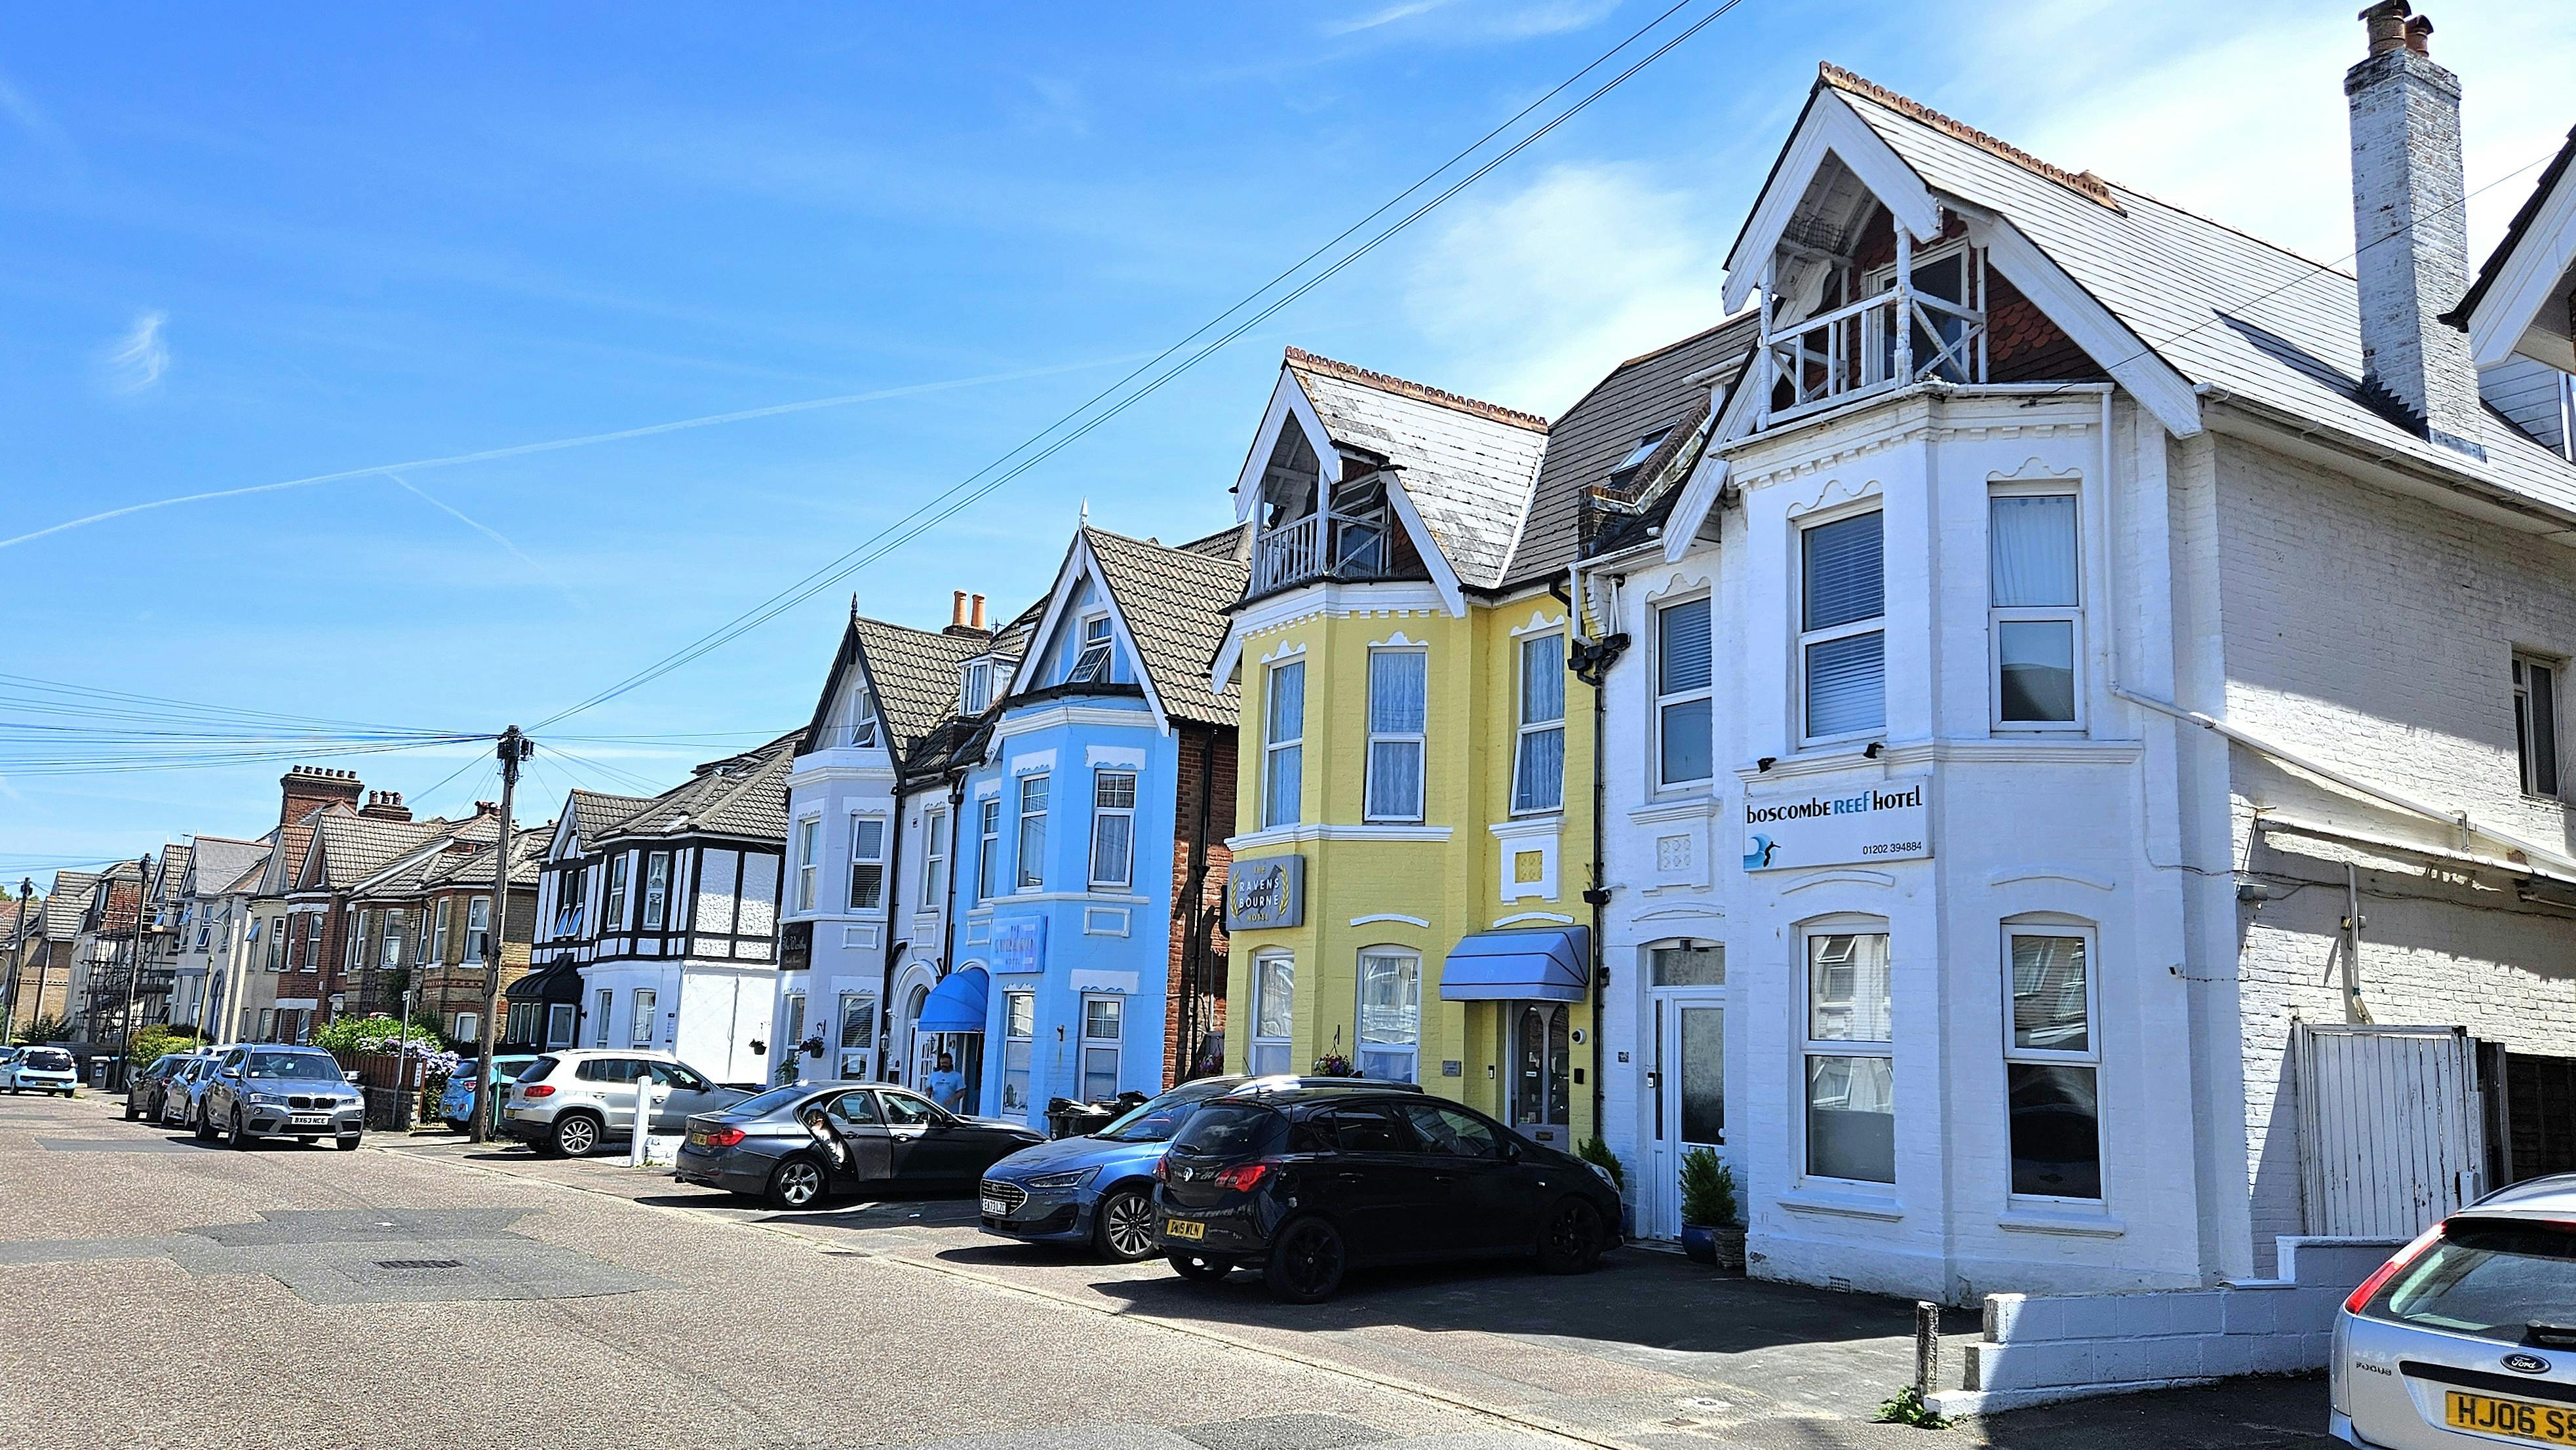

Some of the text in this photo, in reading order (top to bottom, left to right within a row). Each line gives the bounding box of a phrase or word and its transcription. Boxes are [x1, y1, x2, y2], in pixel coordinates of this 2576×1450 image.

[1863, 841, 1921, 854] 01202 394884
[1240, 878, 1279, 892] RAVENS
[1239, 895, 1279, 908] BOURNE
[1247, 914, 1269, 922] HOTEL
[2356, 1362, 2392, 1376] FOCUS
[2510, 1355, 2537, 1369] Ford
[2459, 1396, 2535, 1434] HJ06
